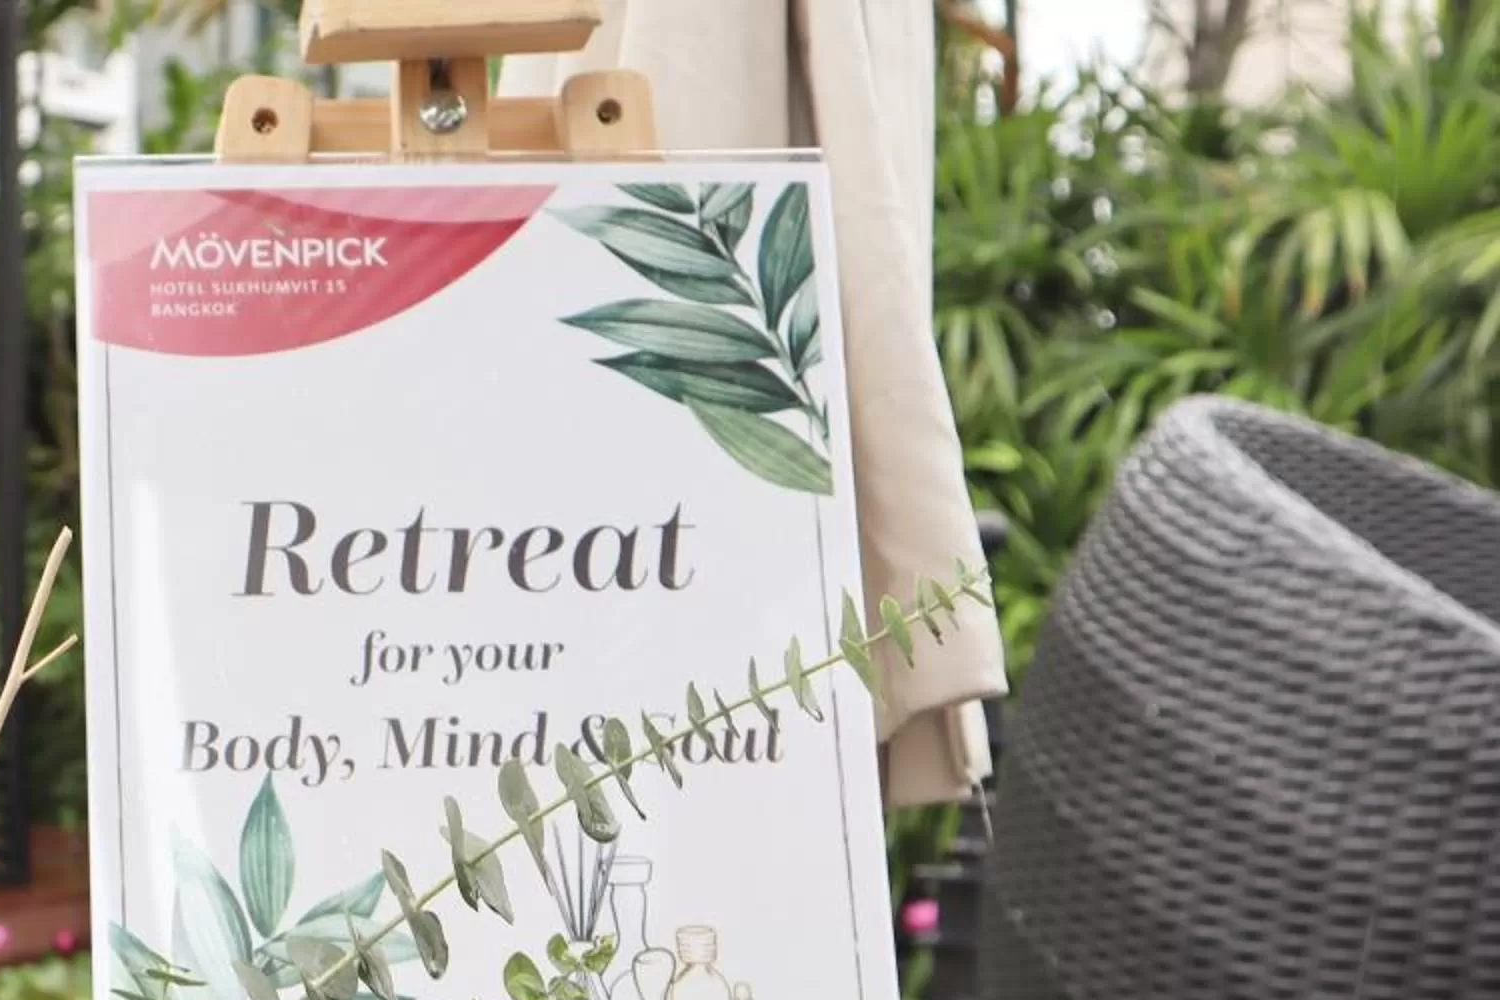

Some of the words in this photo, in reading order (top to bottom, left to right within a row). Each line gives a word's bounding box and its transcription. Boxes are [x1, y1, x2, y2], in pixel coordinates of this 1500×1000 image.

[150, 232, 388, 270] MÖVENPICK
[150, 281, 203, 297] HOTEL
[211, 280, 319, 296] SUKHUMVIT
[326, 279, 347, 294] 15
[151, 302, 238, 318] BANGKOK
[230, 499, 697, 598] Retreat
[349, 629, 434, 686] for
[442, 639, 564, 685] your
[177, 714, 356, 788] Body,
[375, 710, 552, 770] Mind
[570, 713, 616, 768] &
